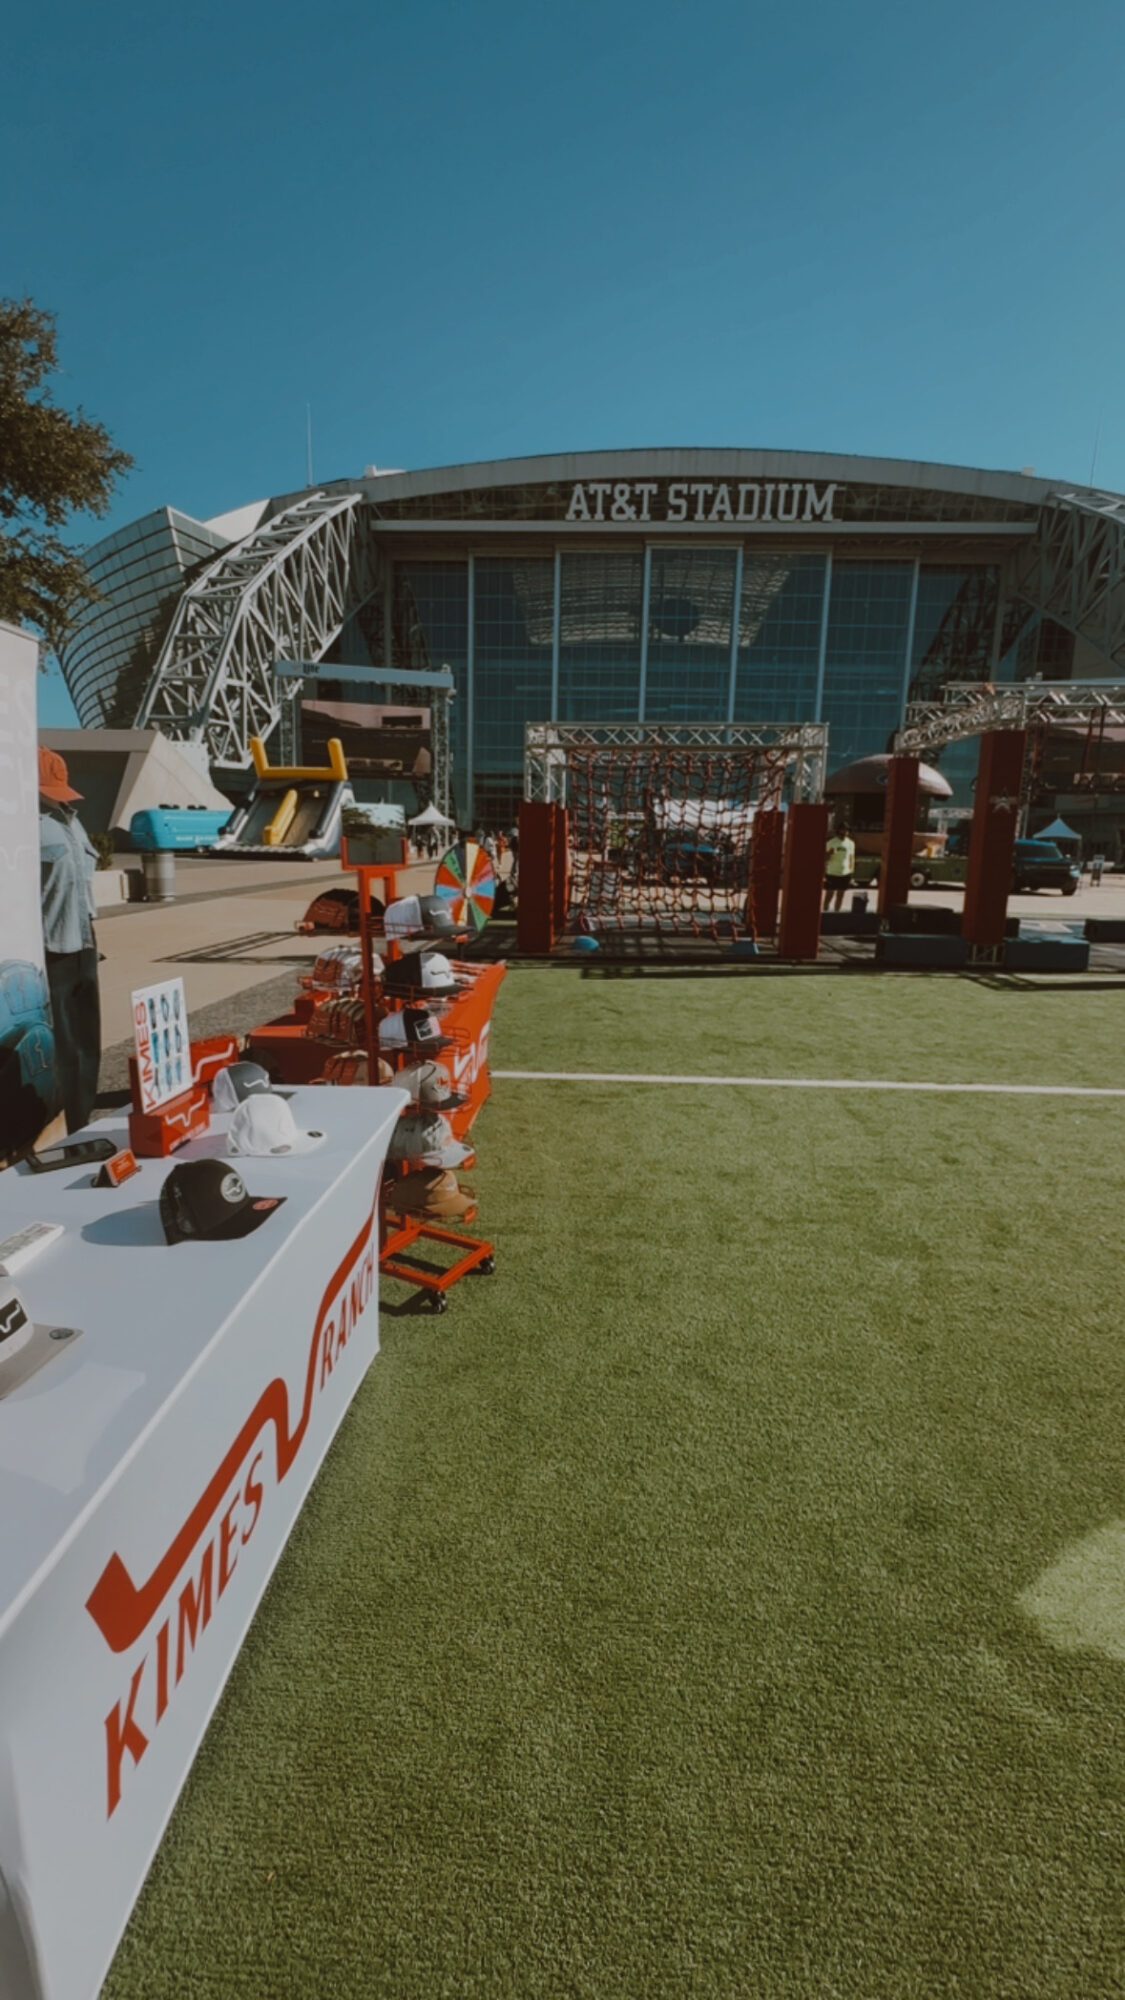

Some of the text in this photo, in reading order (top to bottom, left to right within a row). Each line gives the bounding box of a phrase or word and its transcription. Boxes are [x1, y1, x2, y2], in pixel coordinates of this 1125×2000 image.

[565, 483, 840, 521] AT&T STADIUM
[135, 1001, 156, 1108] KIMES
[104, 1242, 374, 1821] KIMES RANCH
